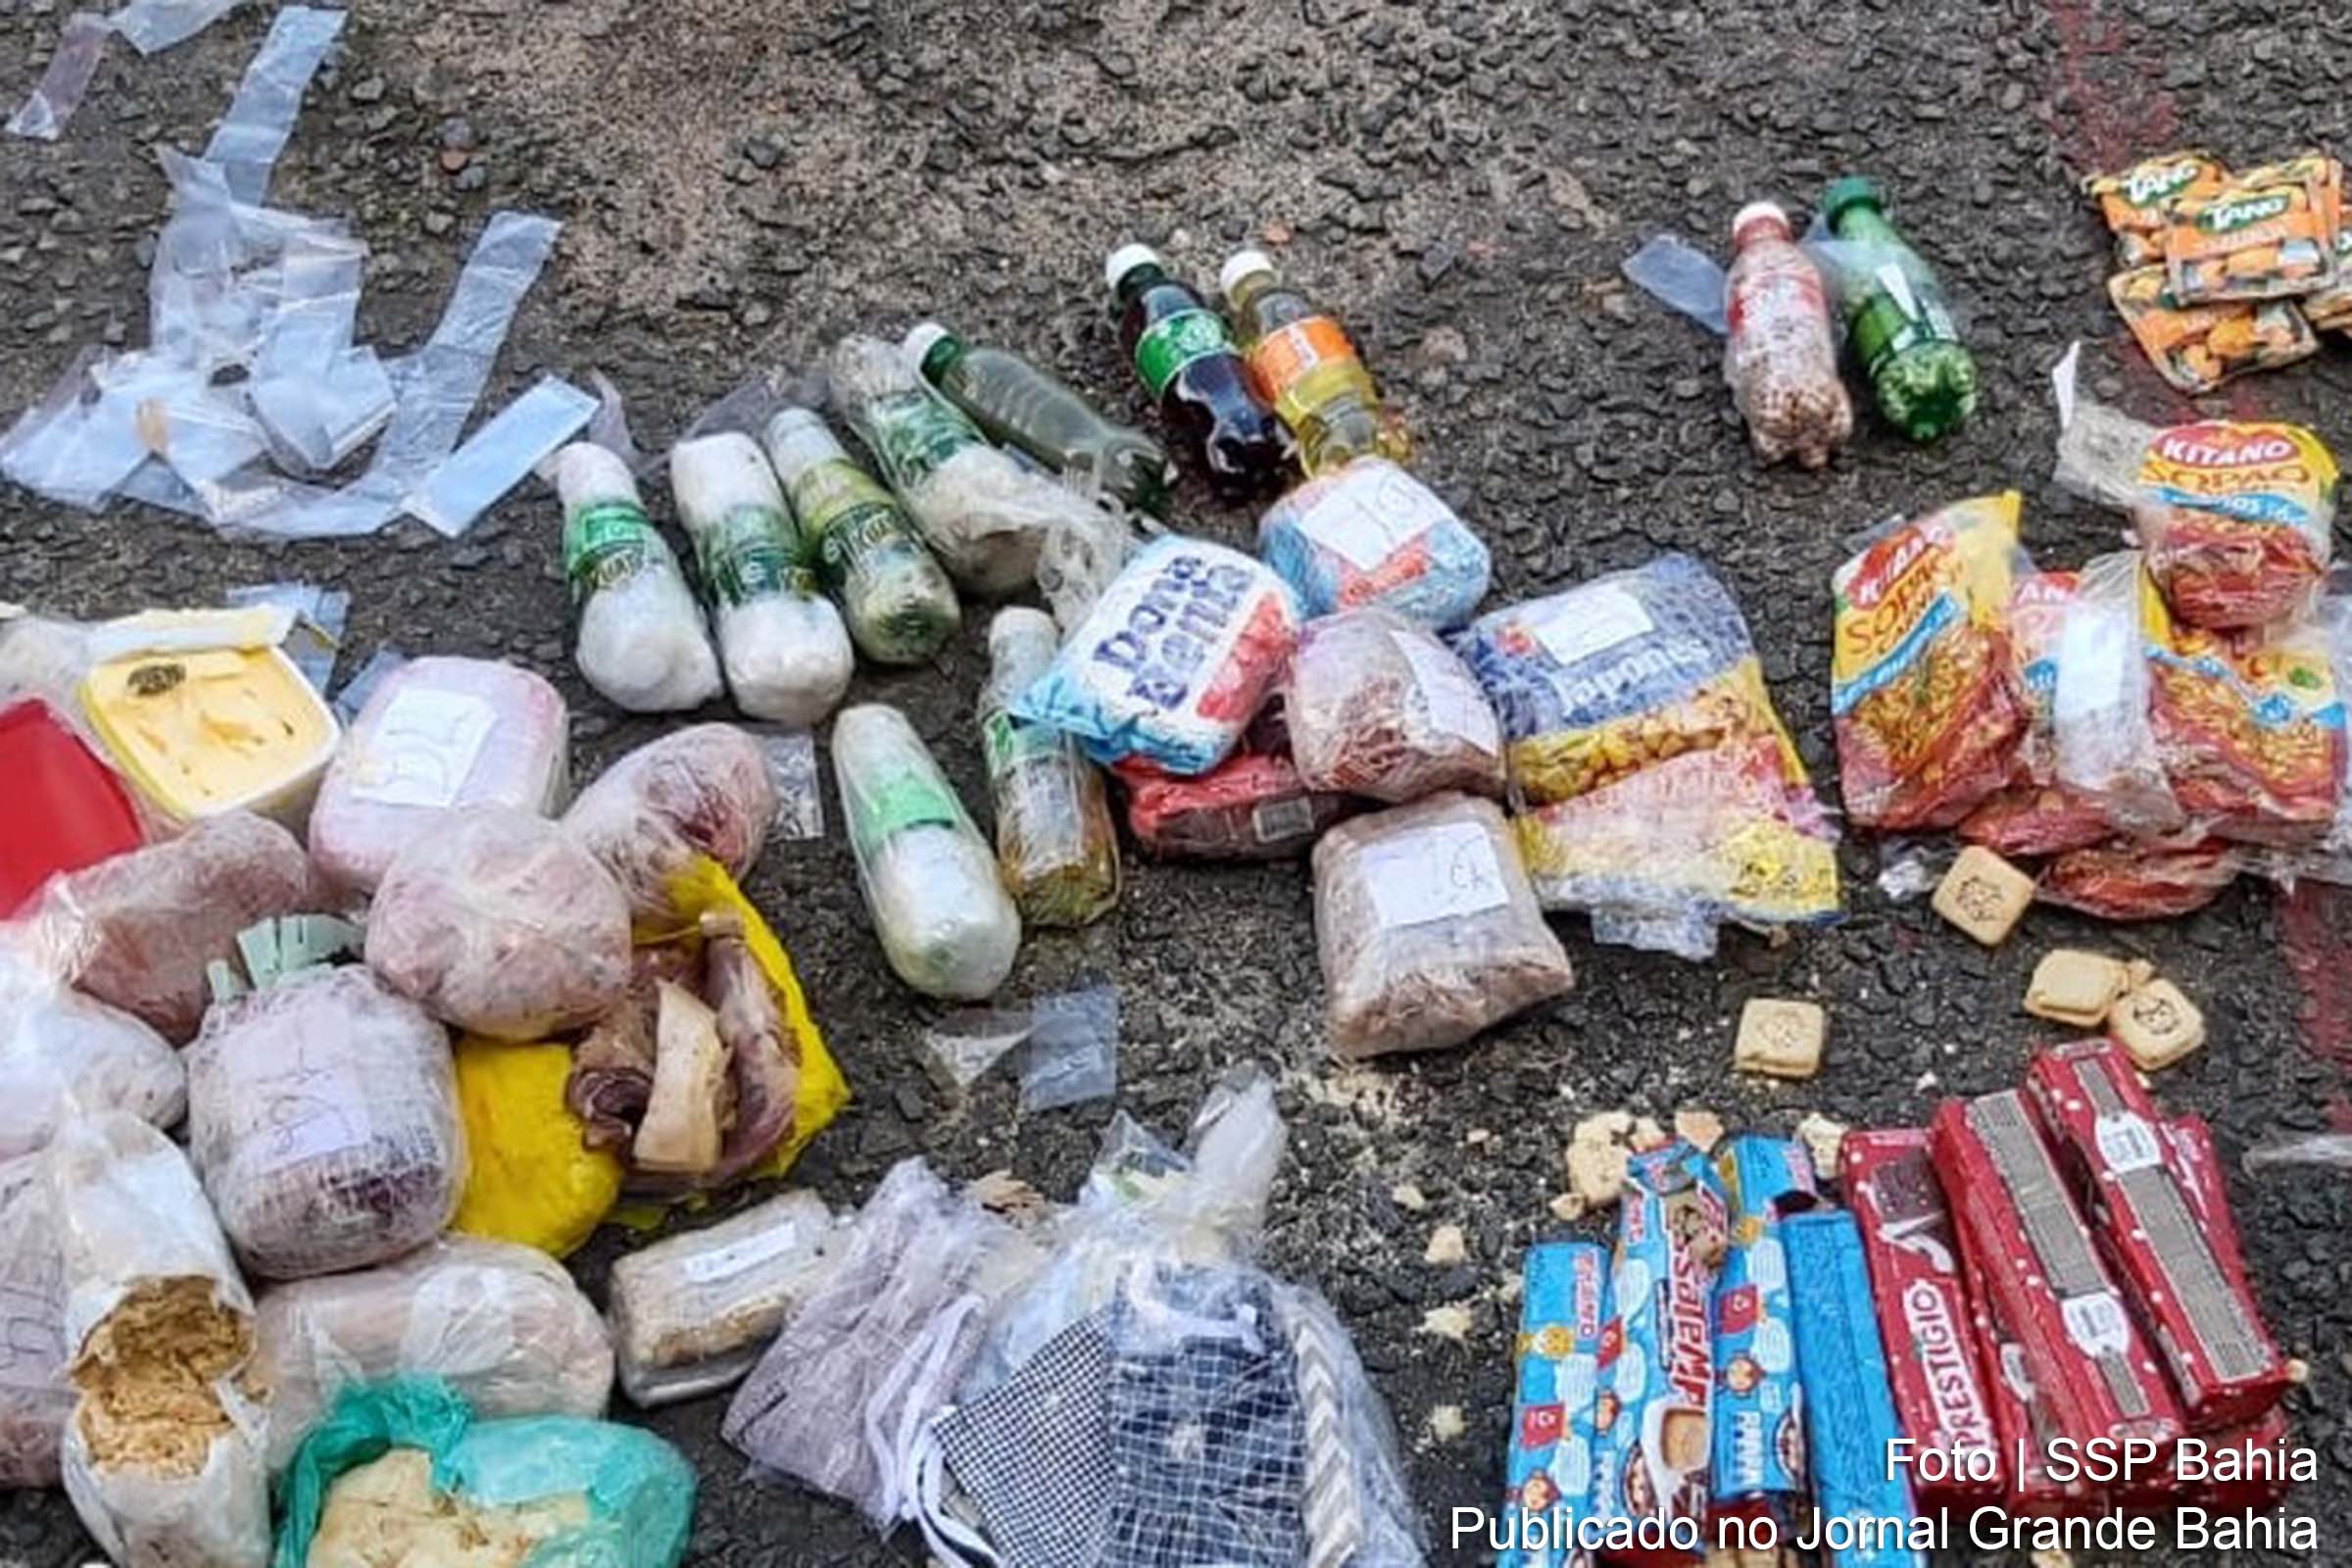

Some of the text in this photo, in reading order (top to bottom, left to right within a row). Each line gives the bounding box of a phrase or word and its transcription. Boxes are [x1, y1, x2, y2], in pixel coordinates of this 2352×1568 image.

[2162, 439, 2291, 466] KITANO
[1093, 554, 1207, 673] Dona
[1910, 1288, 1984, 1448] PRESTIGIO
